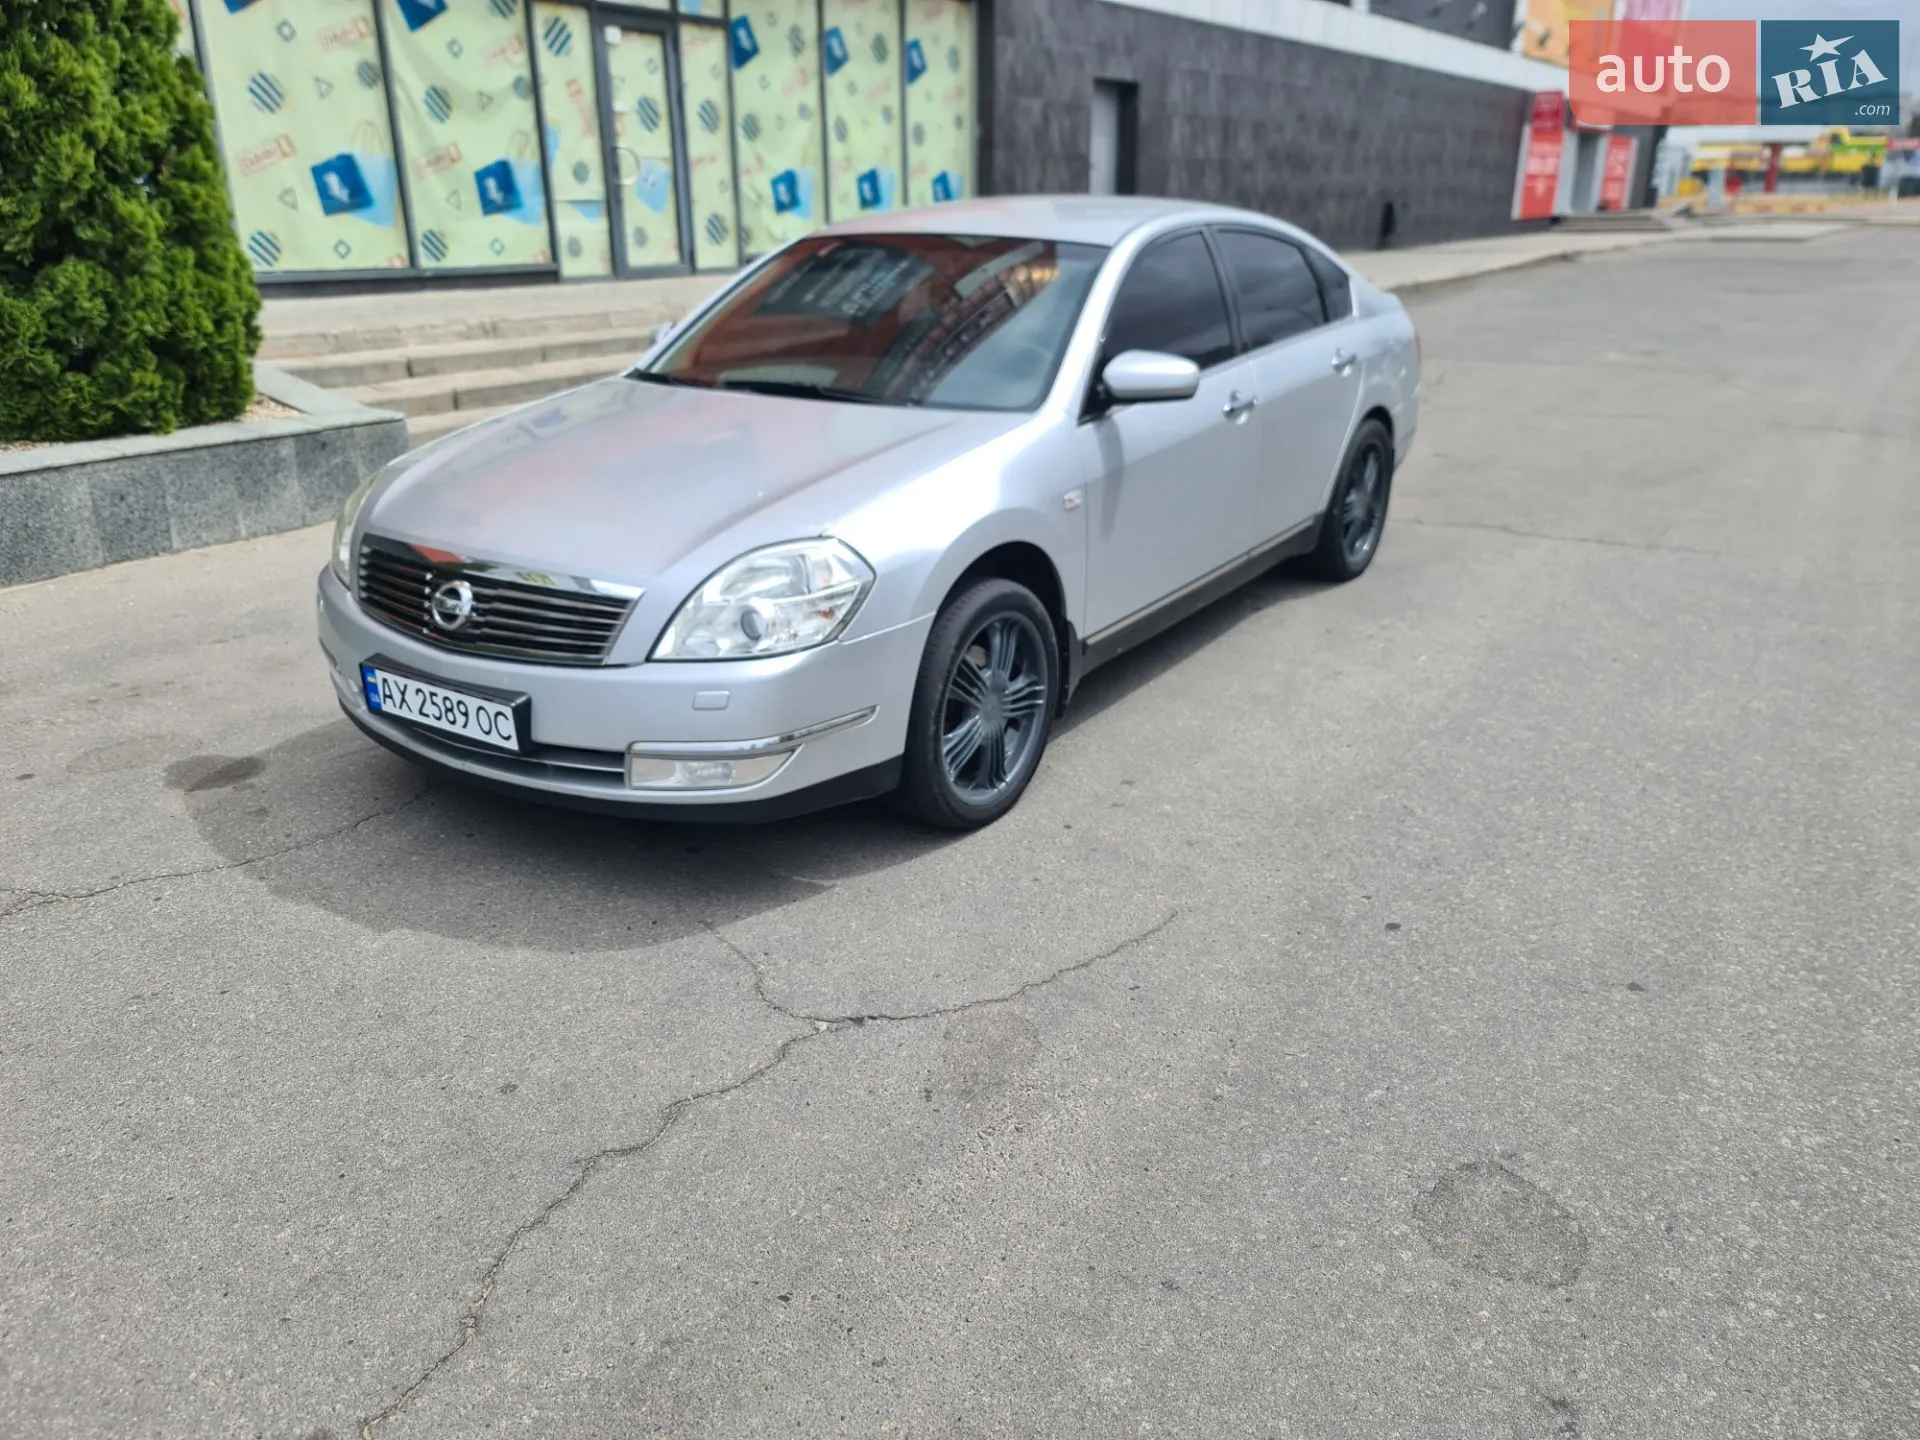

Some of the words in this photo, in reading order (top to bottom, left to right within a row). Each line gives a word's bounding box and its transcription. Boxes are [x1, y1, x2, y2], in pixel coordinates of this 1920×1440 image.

[381, 677, 413, 713] AX
[415, 687, 470, 729] 2589
[475, 705, 512, 741] OC
